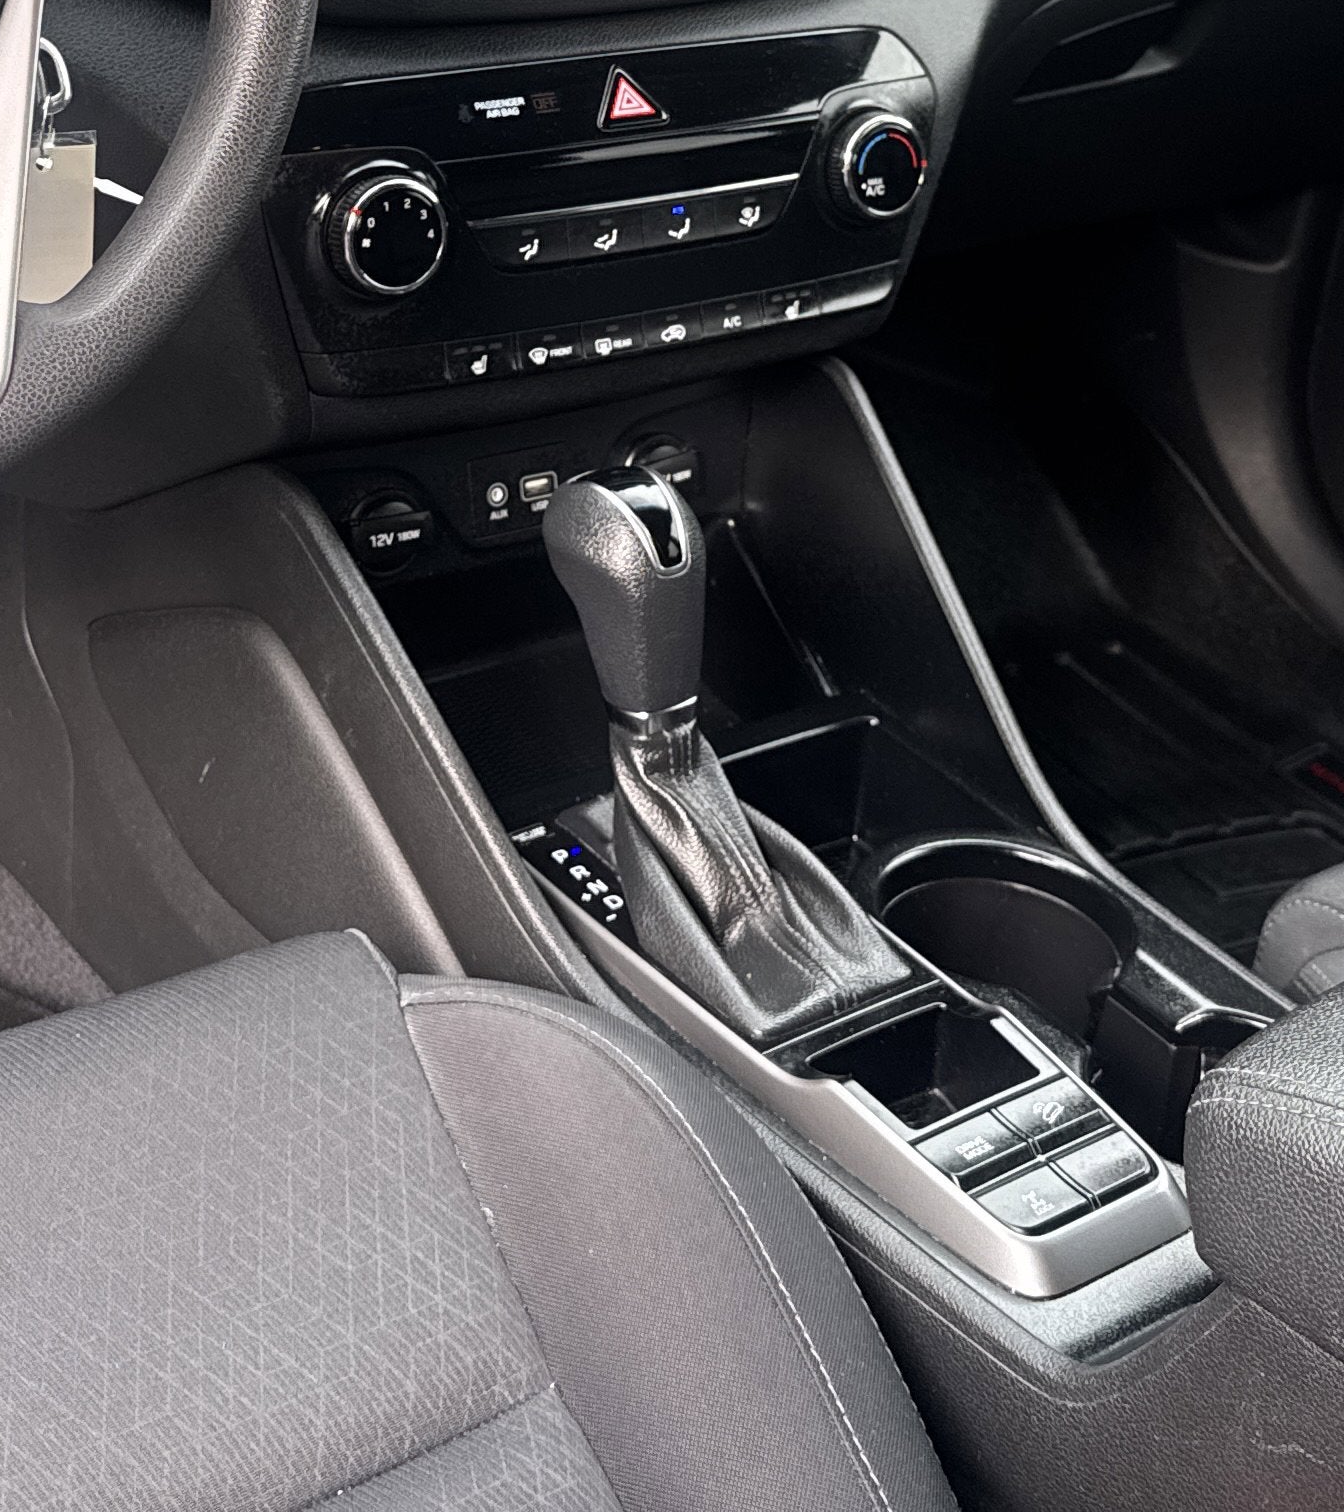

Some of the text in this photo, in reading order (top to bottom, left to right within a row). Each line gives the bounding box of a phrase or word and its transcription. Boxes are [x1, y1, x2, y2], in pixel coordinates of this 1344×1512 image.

[474, 96, 558, 111] PASSENGER OFF
[486, 106, 521, 120] AIR BAG
[865, 184, 886, 197] A/C
[383, 201, 390, 213] 1
[403, 197, 412, 210] 2
[419, 209, 428, 221] 3
[367, 217, 376, 229] 0
[427, 228, 435, 239] 4
[723, 315, 742, 329] A/C
[612, 338, 633, 349] REAR
[549, 345, 573, 358] FRONT
[489, 508, 509, 521] AUX
[369, 532, 395, 548] 12V
[551, 848, 569, 864] P
[569, 864, 591, 881] R
[586, 878, 609, 896] N
[602, 894, 624, 910] D
